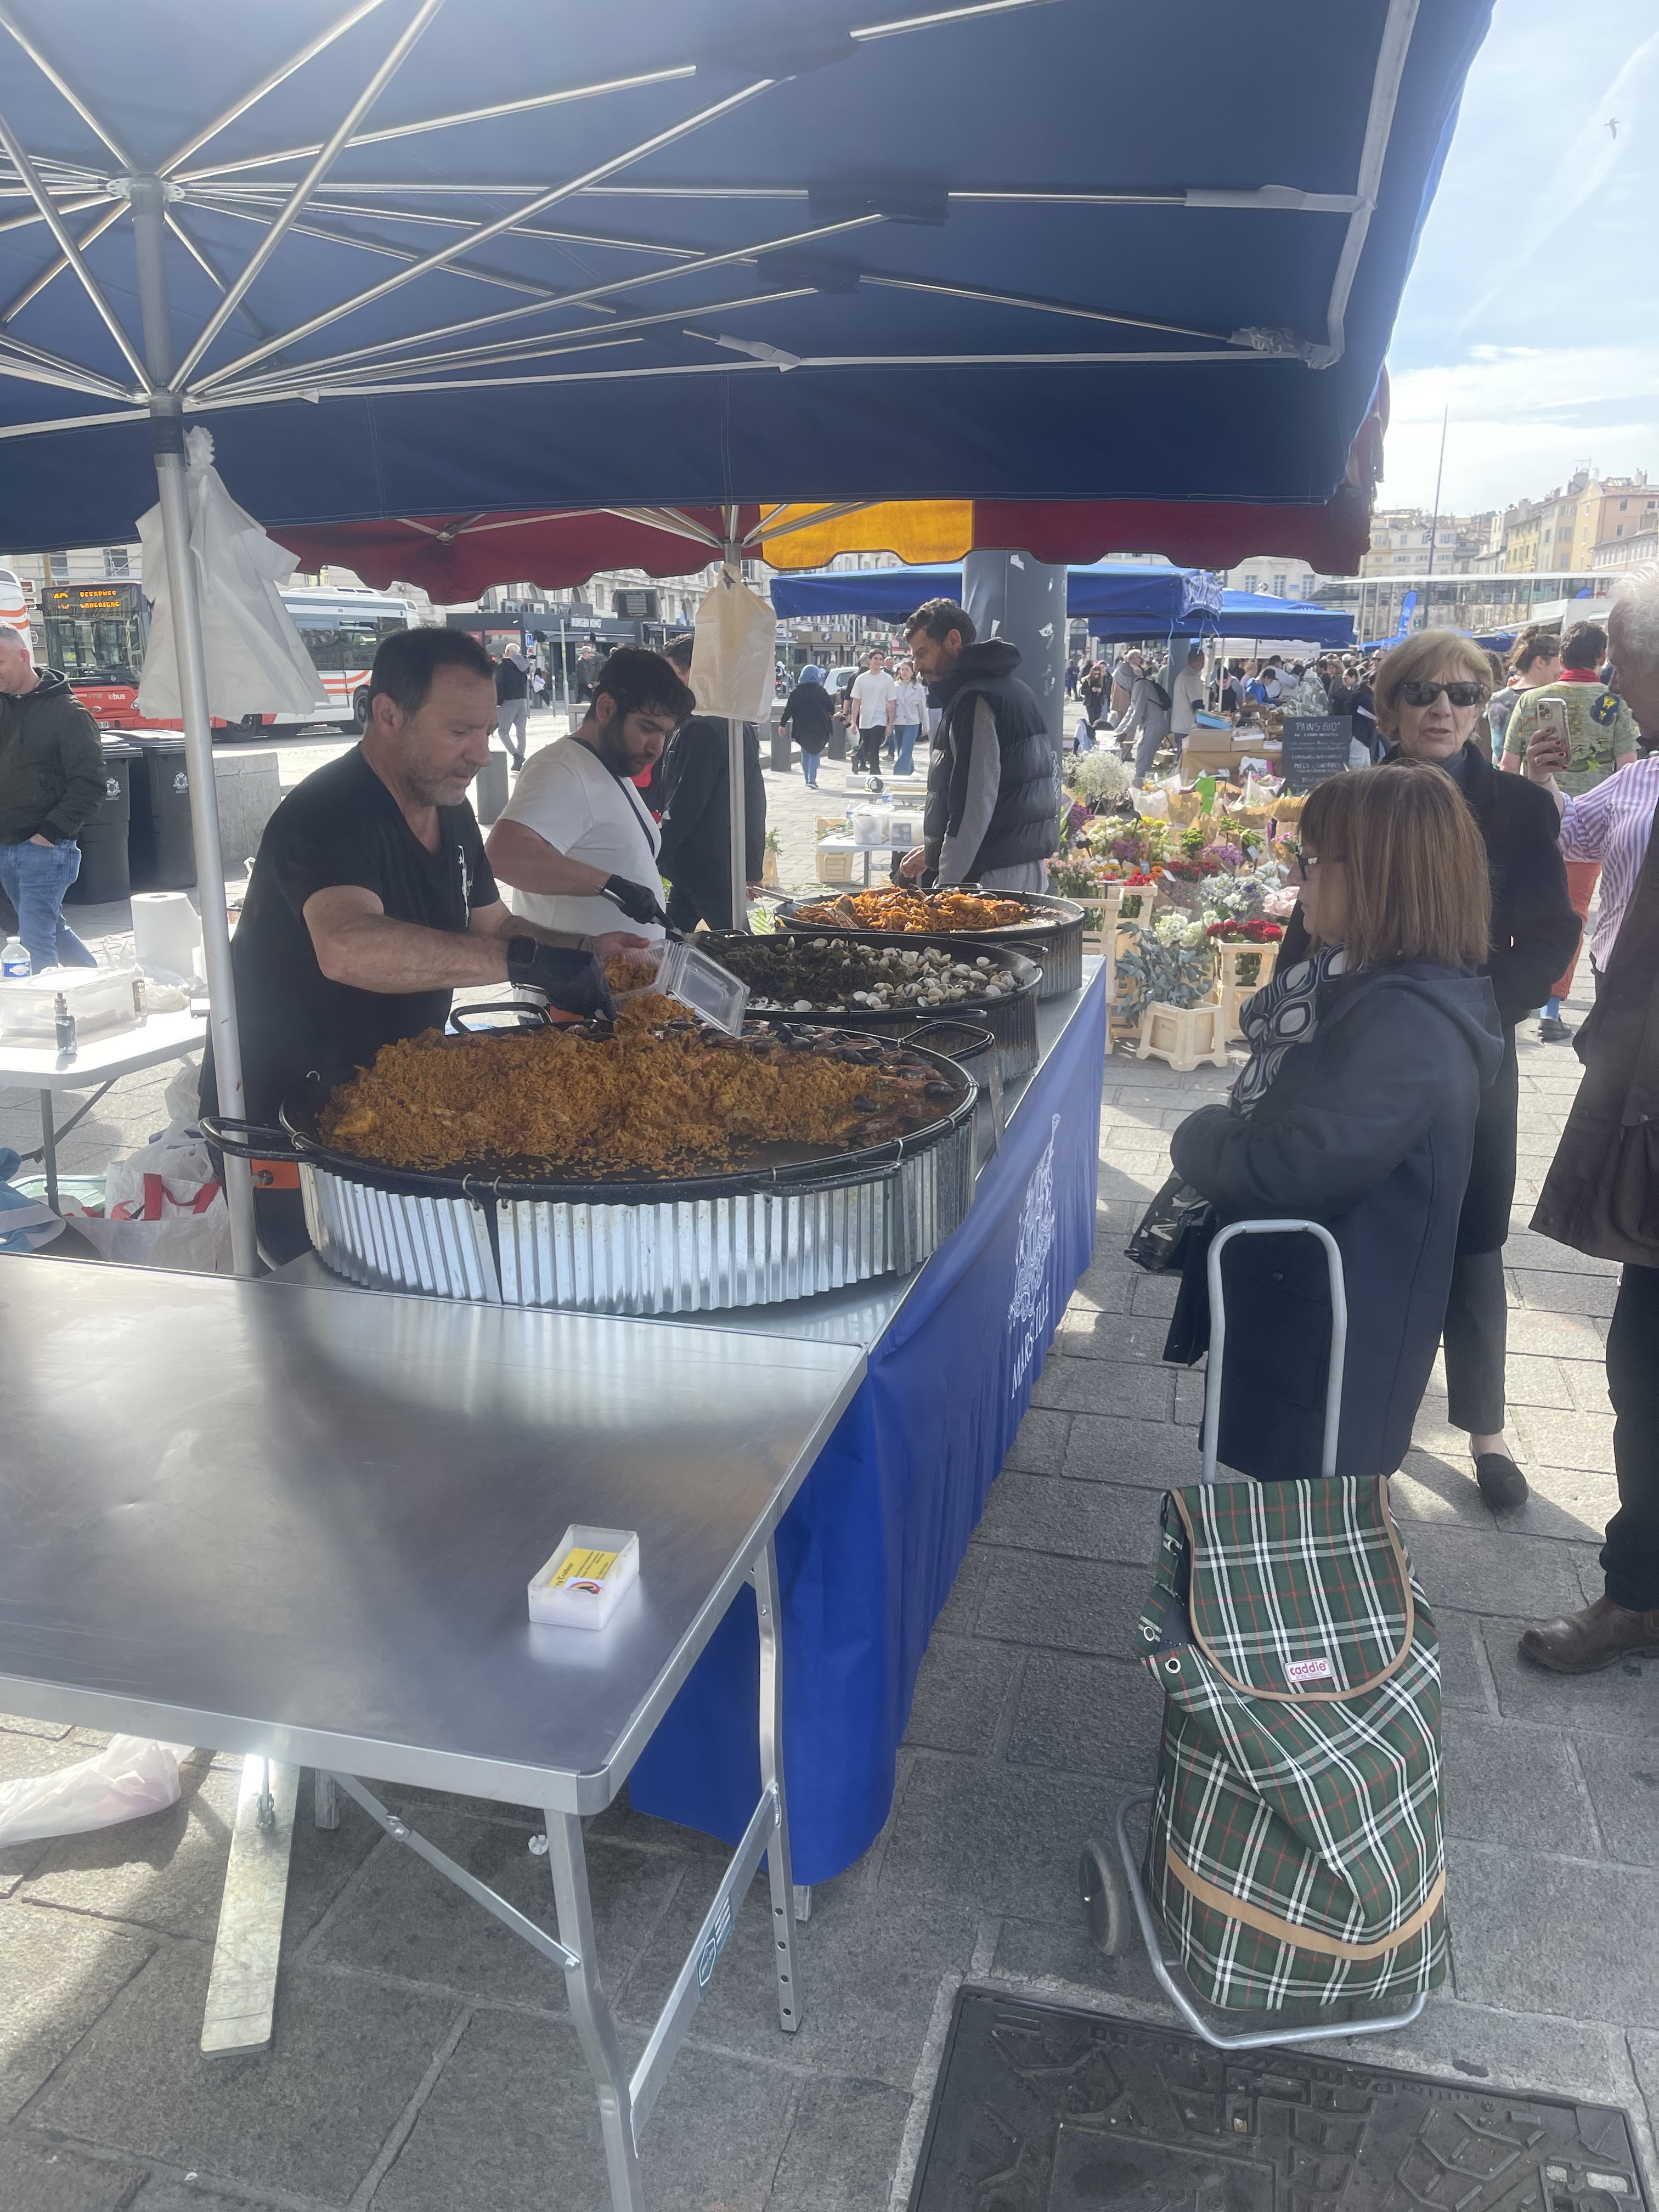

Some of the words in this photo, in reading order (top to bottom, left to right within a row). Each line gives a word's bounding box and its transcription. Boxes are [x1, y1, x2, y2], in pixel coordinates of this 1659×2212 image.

[571, 618, 589, 628] BURGER
[590, 618, 602, 628] KING
[1290, 1661, 1326, 1675] caddie
